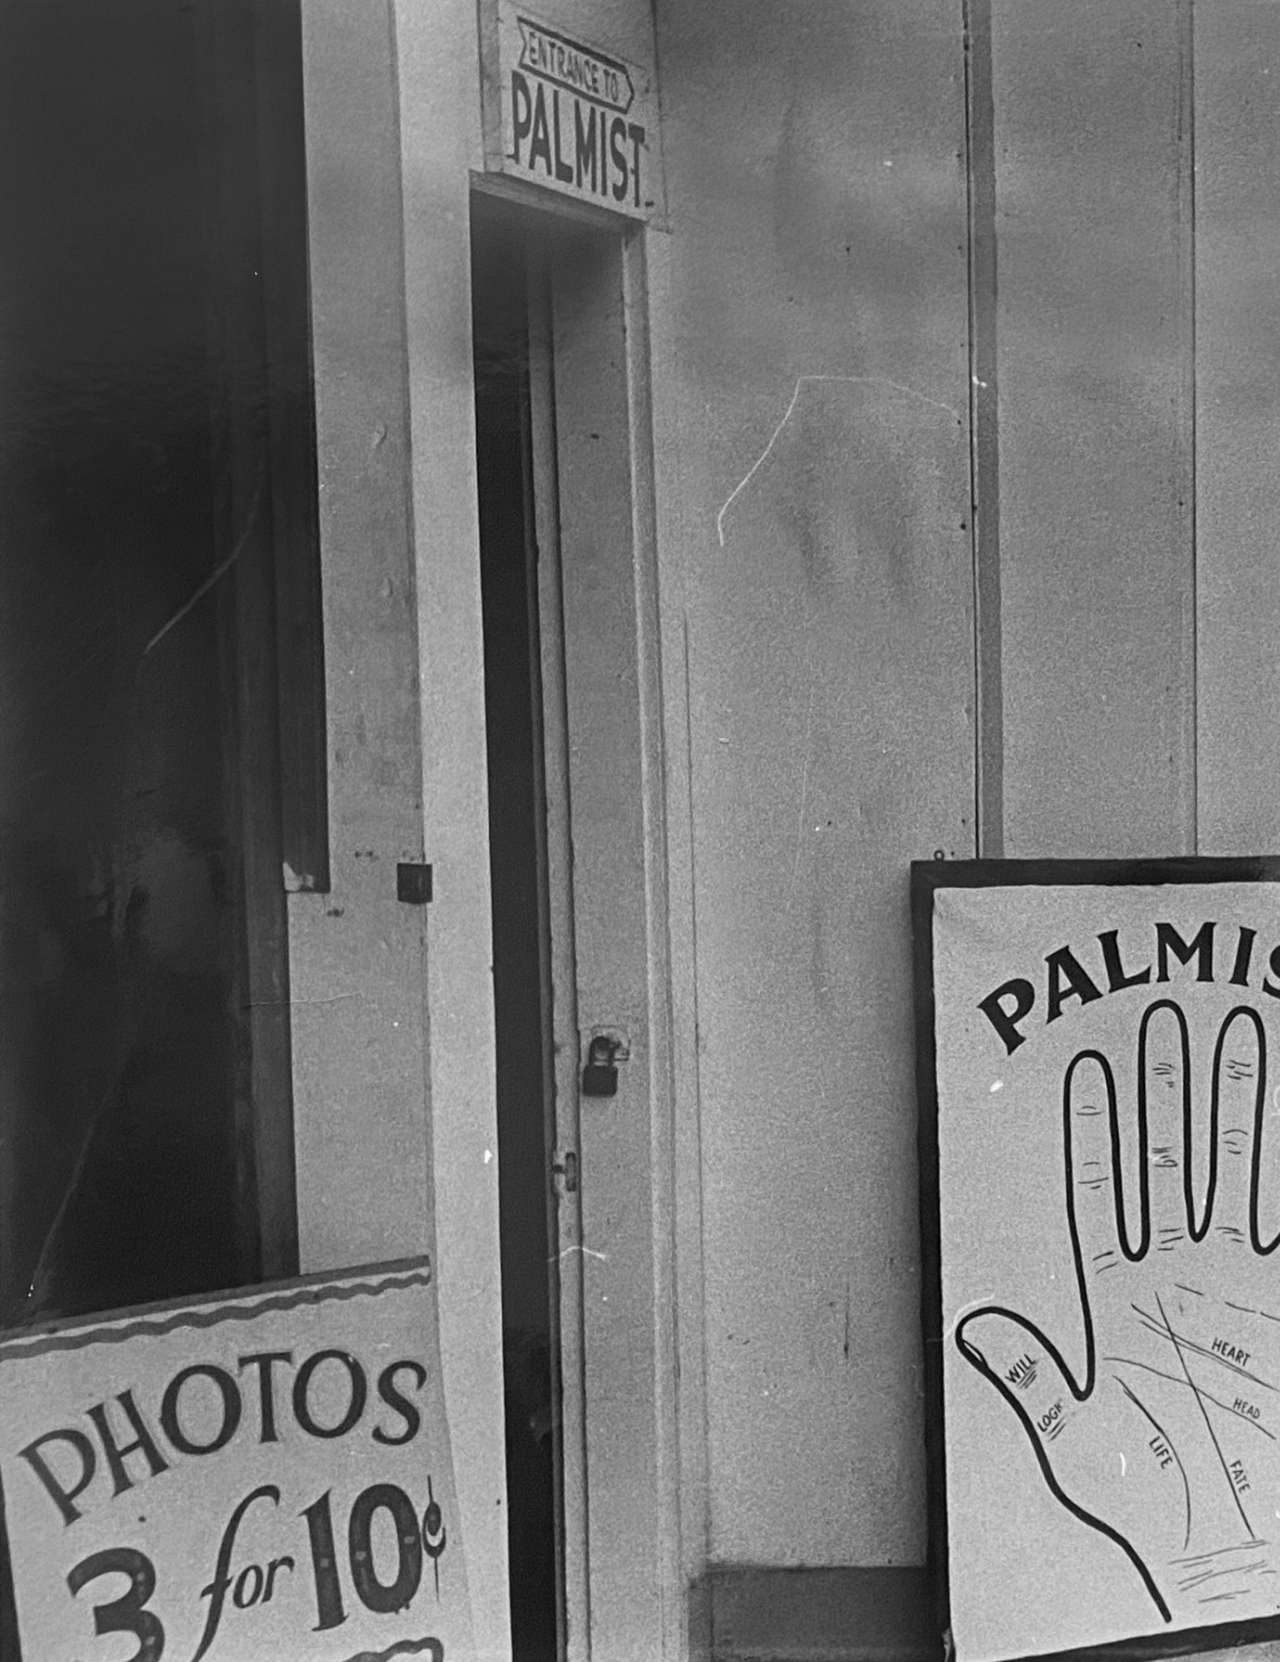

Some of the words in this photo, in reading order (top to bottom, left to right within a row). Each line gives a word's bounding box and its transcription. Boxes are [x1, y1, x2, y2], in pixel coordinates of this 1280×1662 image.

[528, 31, 599, 94] ENTRANCE
[603, 68, 619, 102] TO
[507, 69, 645, 208] PALMIST
[1004, 1353, 1037, 1384] WILL
[1210, 1336, 1252, 1367] HEART
[1232, 1397, 1261, 1420] HEAD
[18, 1348, 428, 1528] PHOTOS
[1149, 1435, 1174, 1469] LIFE
[1229, 1459, 1251, 1494] FATE
[66, 1546, 166, 1662] 3
[190, 1484, 295, 1662] for
